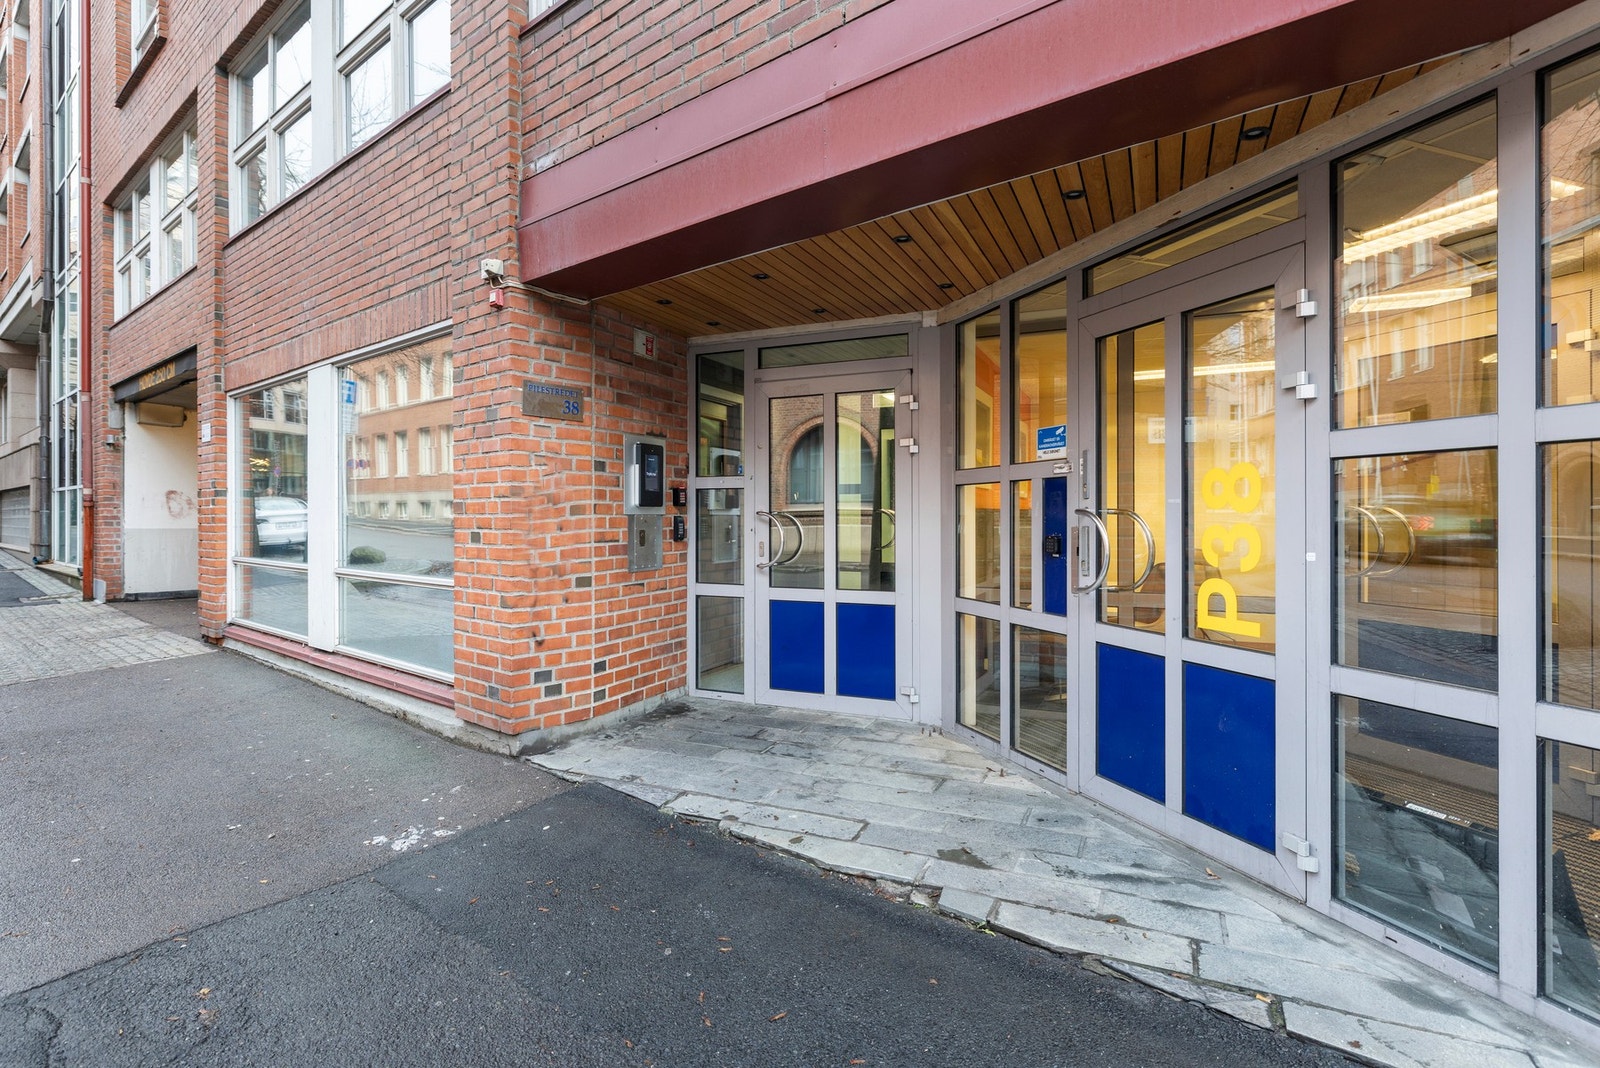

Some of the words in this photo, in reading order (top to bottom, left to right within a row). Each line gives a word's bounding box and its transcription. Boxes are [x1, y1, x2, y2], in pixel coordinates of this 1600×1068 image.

[528, 384, 578, 398] PILESTREDET
[562, 400, 580, 415] 38
[1197, 462, 1262, 638] P38
